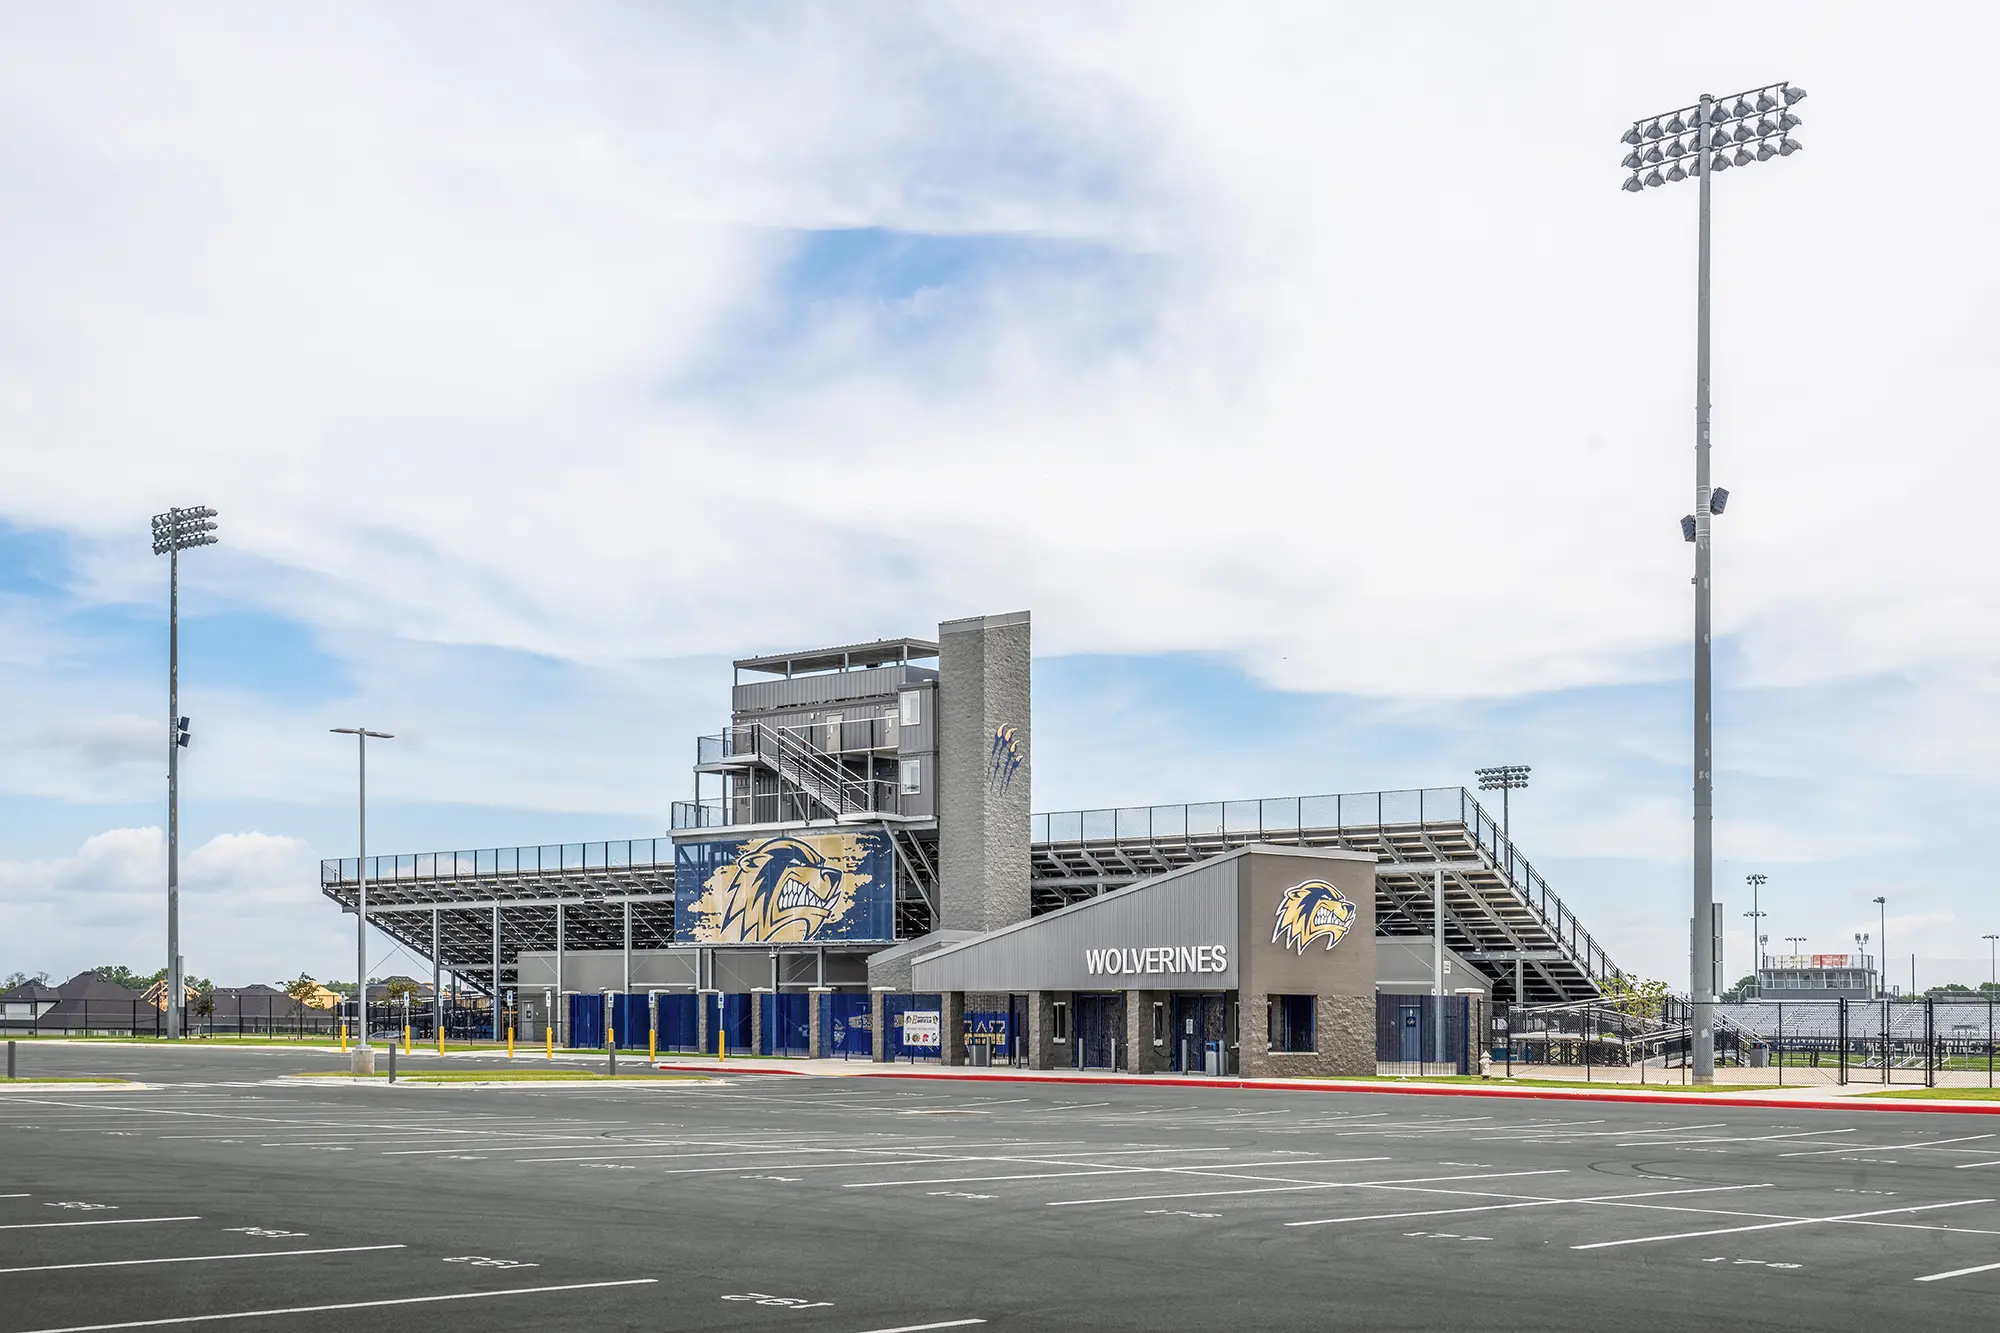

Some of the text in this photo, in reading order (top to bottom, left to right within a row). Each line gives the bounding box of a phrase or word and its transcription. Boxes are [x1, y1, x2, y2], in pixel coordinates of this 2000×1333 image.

[1086, 945, 1228, 974] WOLVERINES
[441, 1255, 540, 1269] 193
[720, 1292, 836, 1309] 192
